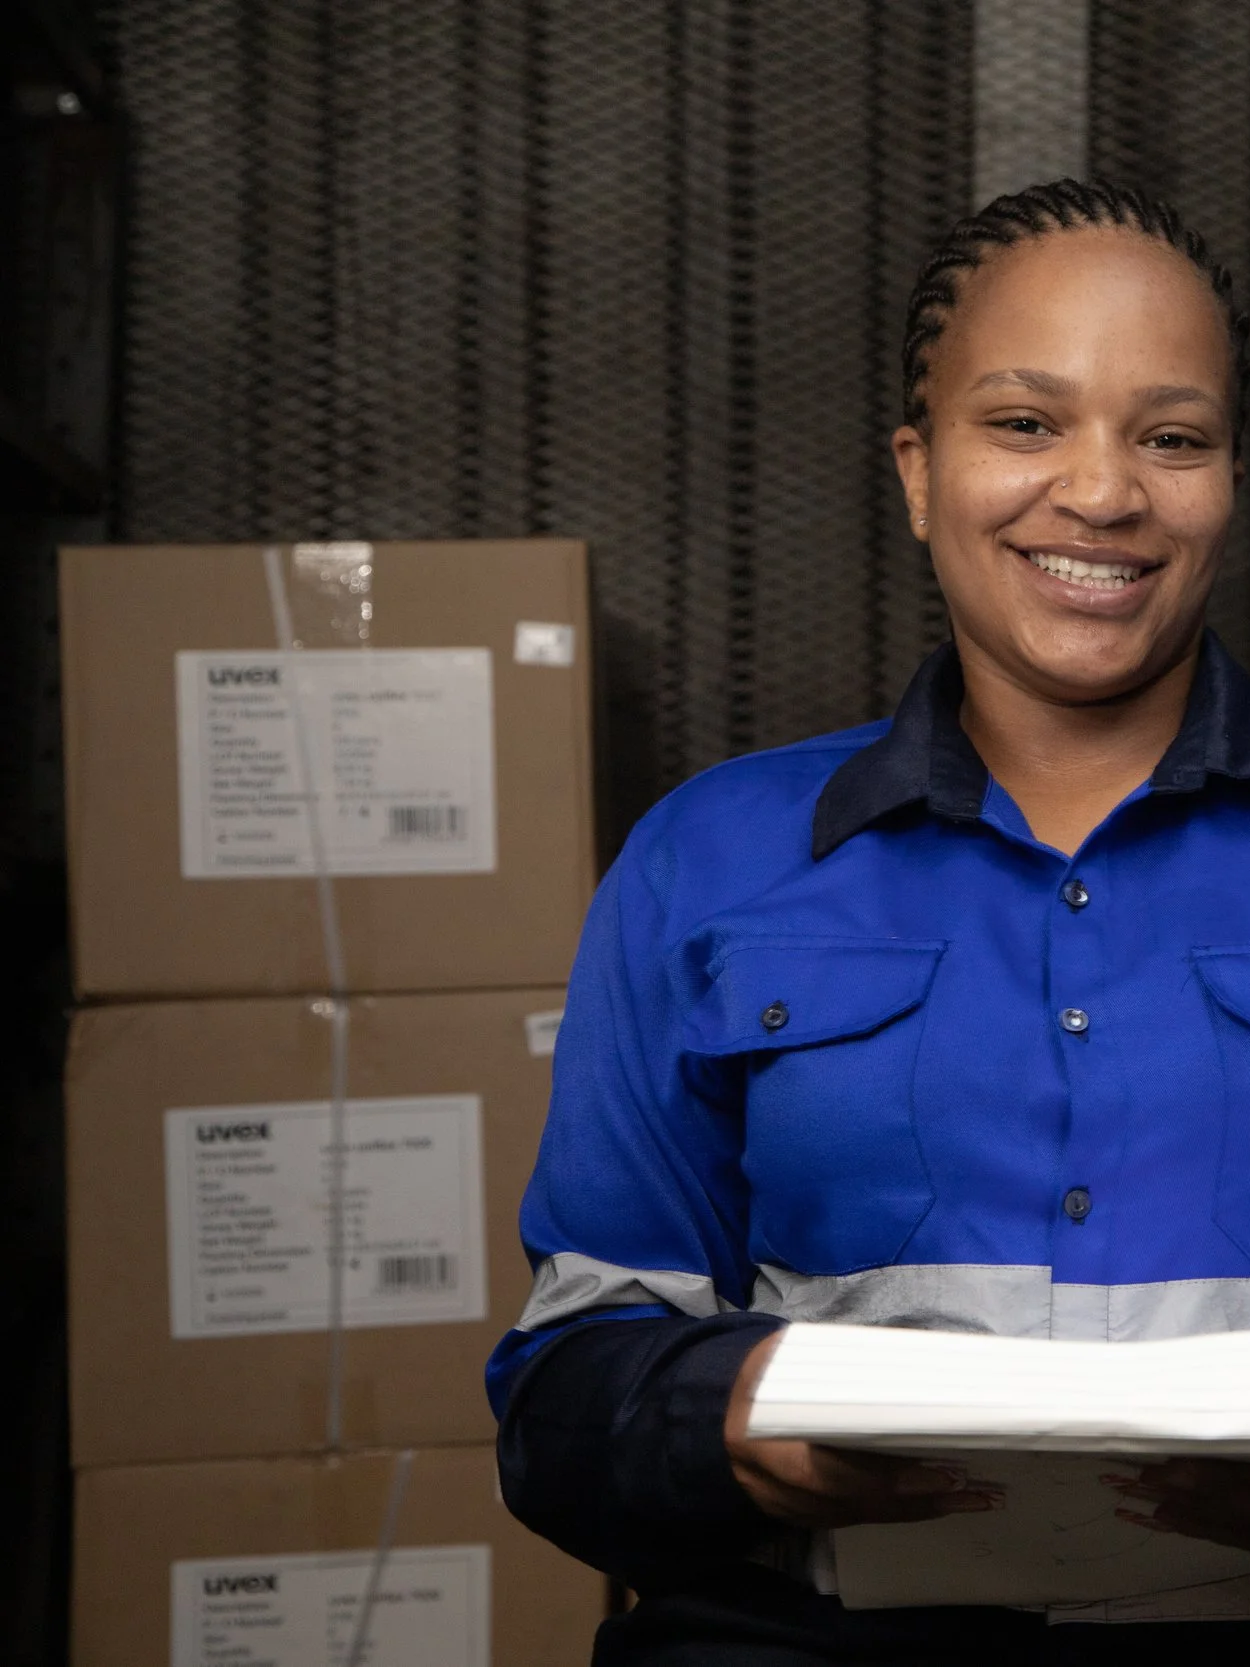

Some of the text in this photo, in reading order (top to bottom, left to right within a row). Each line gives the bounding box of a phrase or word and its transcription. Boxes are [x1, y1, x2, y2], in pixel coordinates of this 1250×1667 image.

[207, 667, 280, 686] uvex
[196, 1121, 271, 1144] uvex
[203, 1574, 279, 1596] uvex
